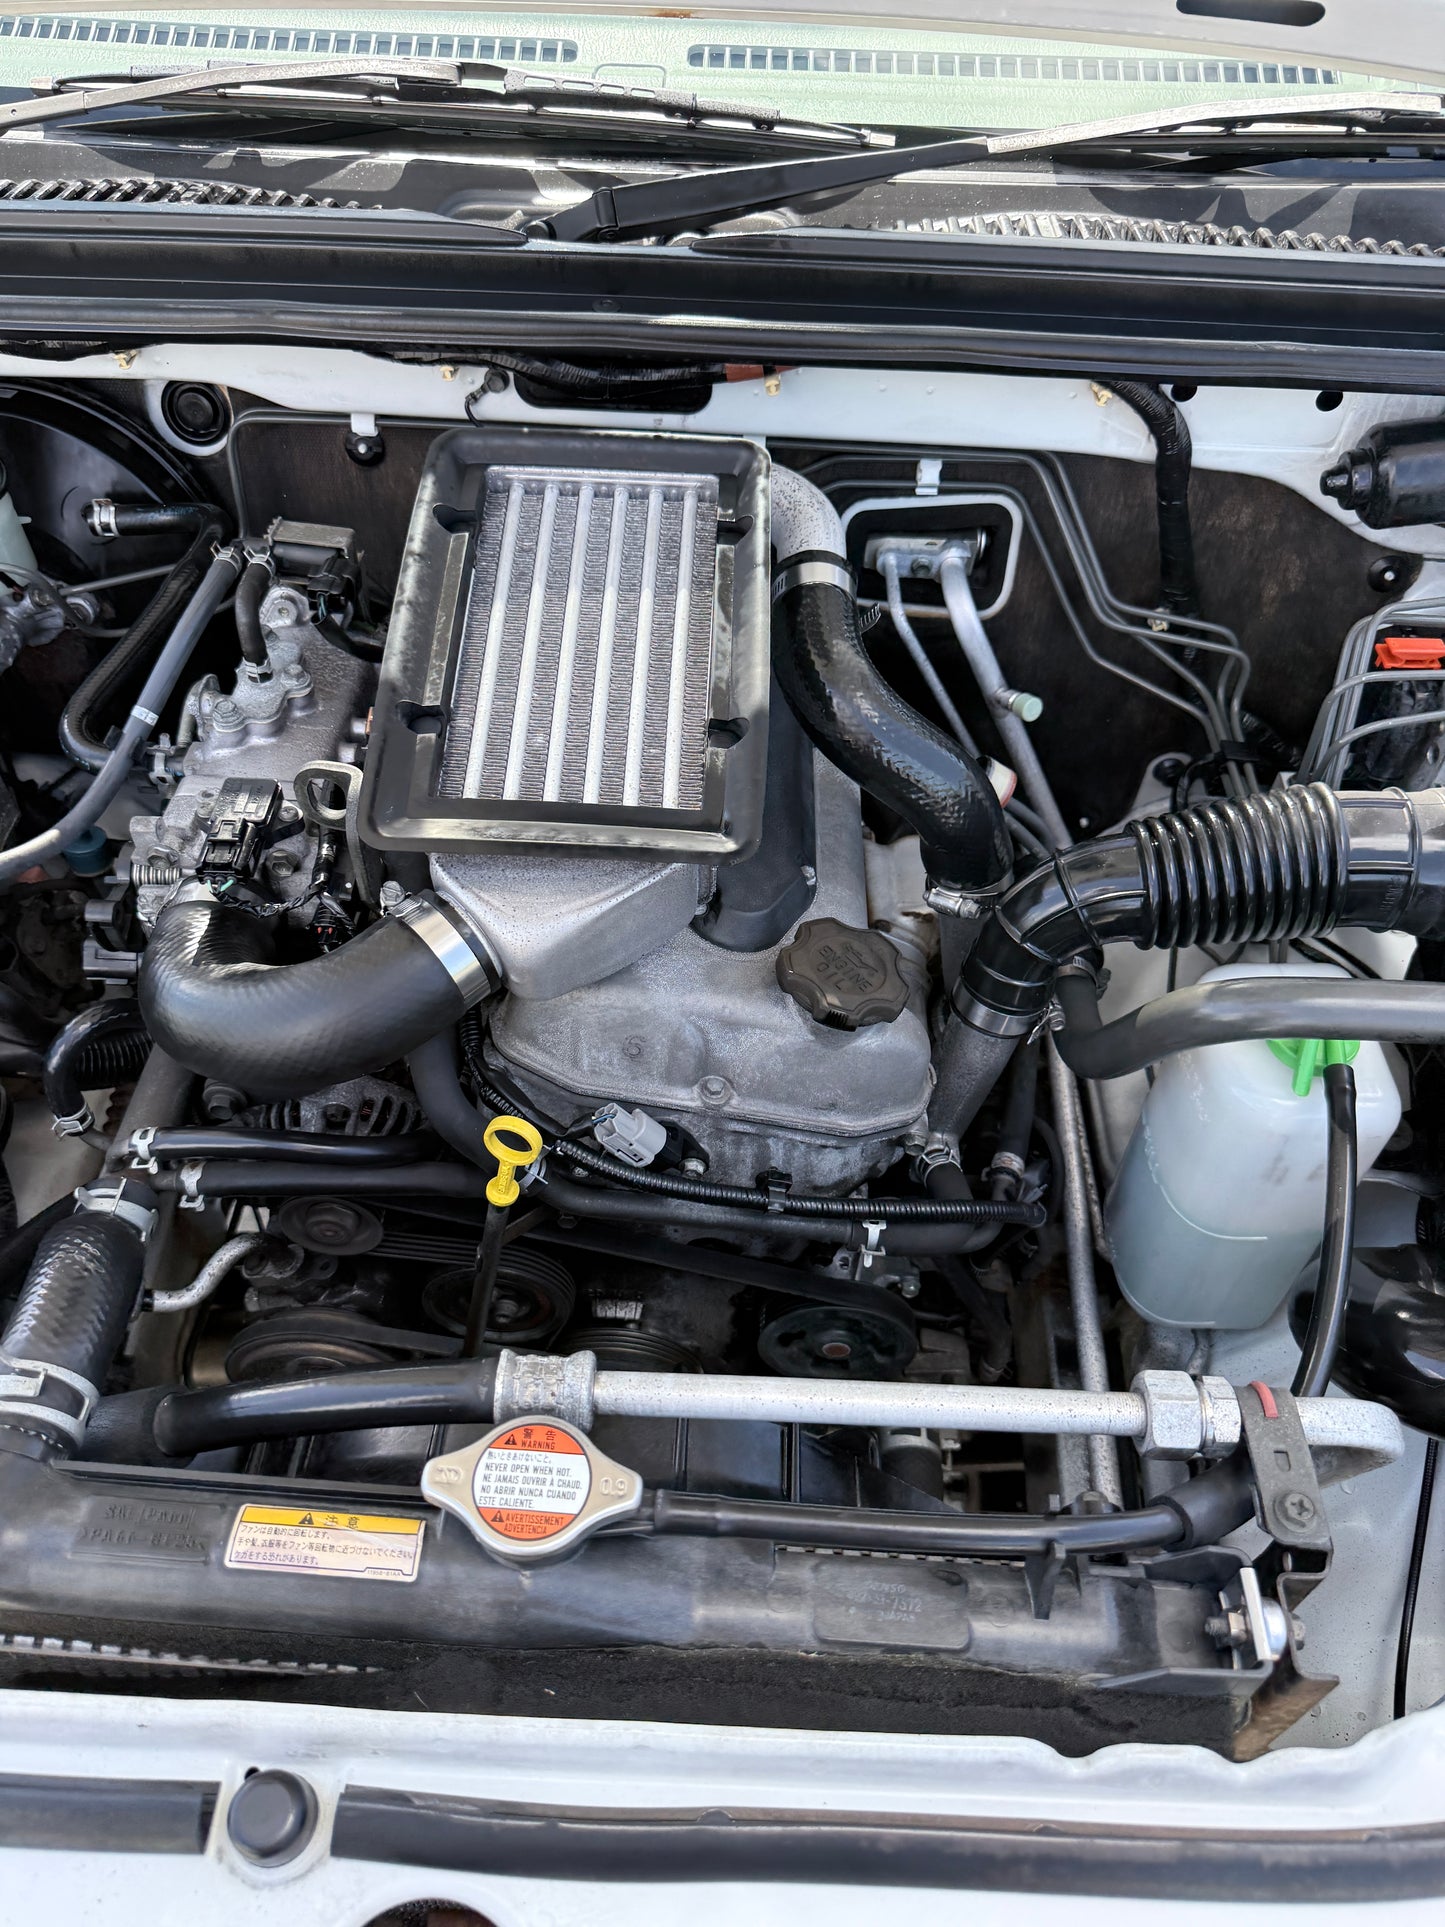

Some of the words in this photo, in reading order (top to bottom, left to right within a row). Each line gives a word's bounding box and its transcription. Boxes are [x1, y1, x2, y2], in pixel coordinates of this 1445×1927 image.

[819, 945, 873, 992] ENGINE
[816, 962, 844, 990] OIL
[521, 1440, 556, 1450] WARNING
[485, 1463, 508, 1473] NEVER
[510, 1464, 530, 1474] OPEN
[533, 1466, 553, 1475] WHEN
[483, 1473, 491, 1483] NE
[494, 1474, 520, 1485] JAMAIS
[522, 1476, 547, 1486] OUVRIR
[480, 1485, 492, 1494] NO
[494, 1486, 516, 1495] ABRIR
[518, 1488, 543, 1498] NUNCA
[546, 1490, 577, 1500] CUANDO
[599, 1476, 629, 1498] 0.9
[478, 1496, 497, 1506] ESTE
[324, 1514, 360, 1529] 注意
[505, 1513, 564, 1526] AVERTISSEMENT
[503, 1523, 547, 1534] ADVERTENCIA
